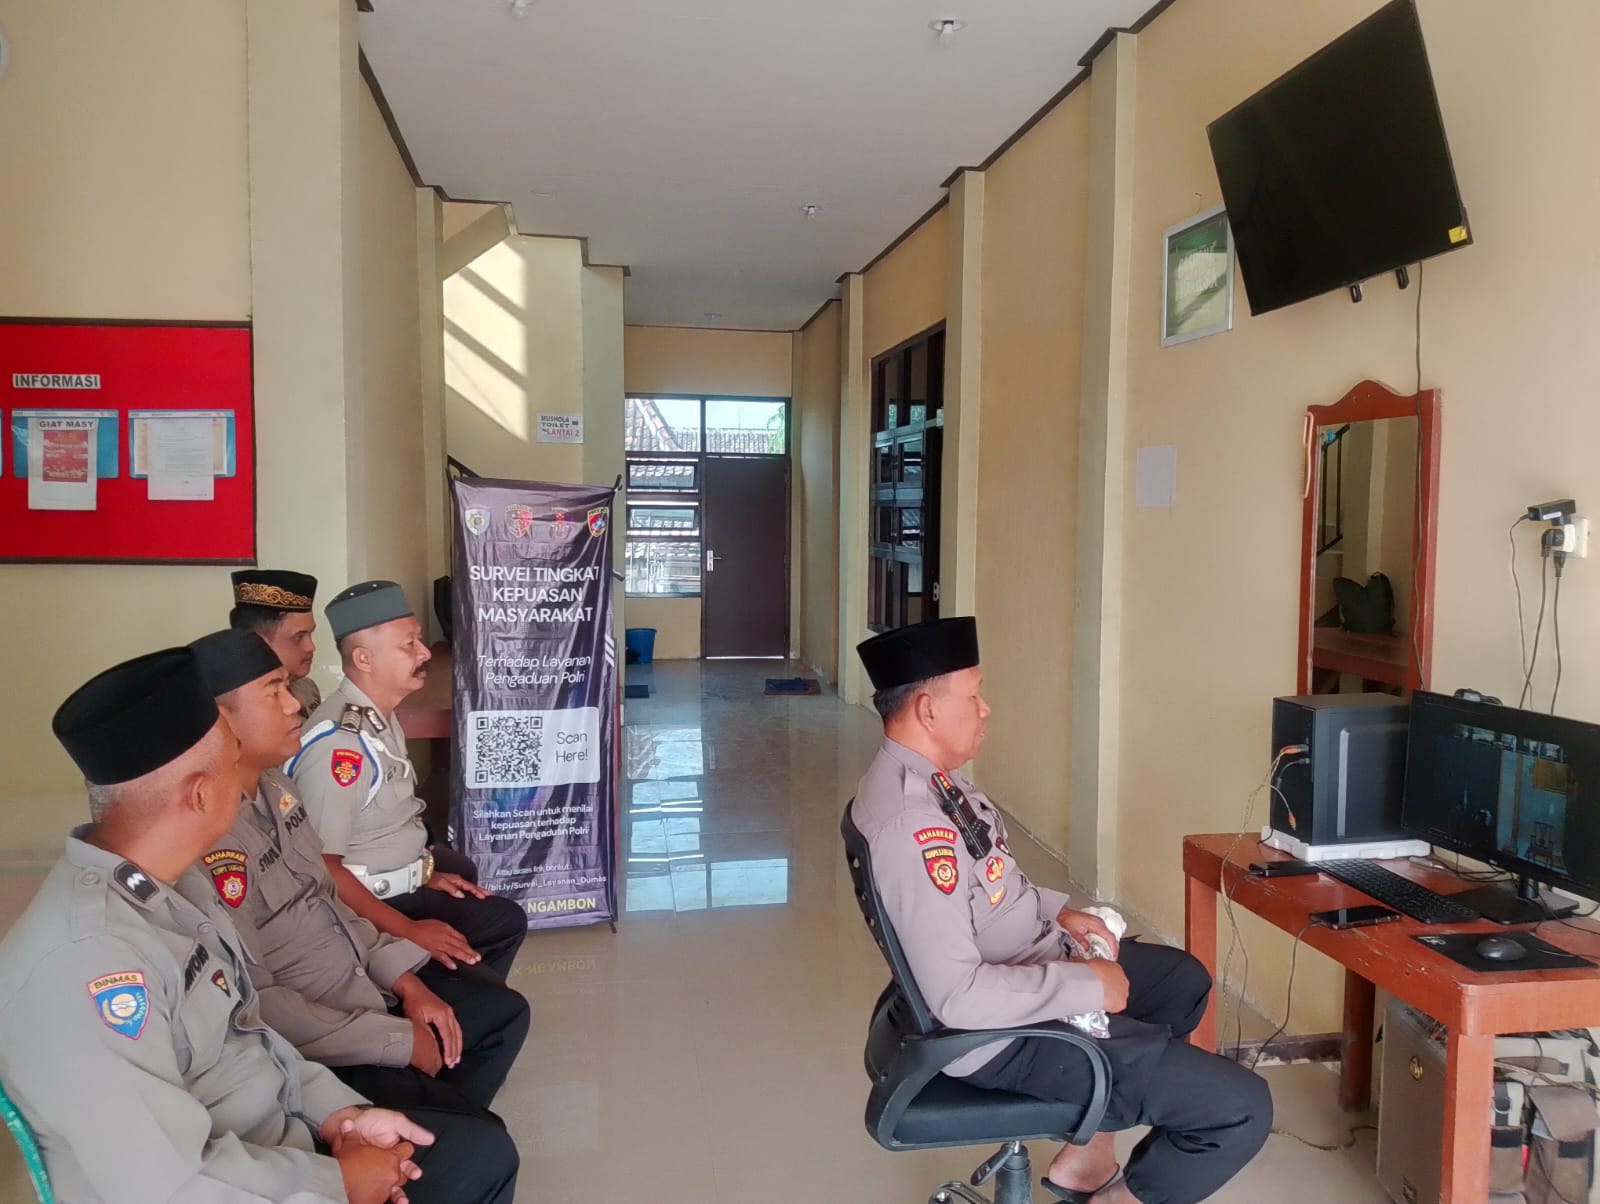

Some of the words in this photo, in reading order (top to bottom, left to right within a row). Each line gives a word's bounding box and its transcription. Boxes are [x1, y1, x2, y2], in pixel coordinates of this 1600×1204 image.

[14, 375, 98, 388] INFORMASI
[39, 420, 63, 428] GIAT
[66, 420, 94, 428] MASY
[470, 566, 531, 581] SURVEI
[534, 566, 600, 582] TINGKAT
[493, 587, 583, 602] KEPUASAN
[478, 607, 593, 622] MASYARAKAT
[478, 656, 539, 669] Terhadap
[542, 656, 591, 669] Layanan
[485, 672, 557, 686] Pengaduan
[561, 671, 585, 683] Polri
[556, 731, 588, 745] Scan
[555, 748, 588, 764] Here!
[473, 809, 511, 819] Silahkan
[513, 808, 535, 817] Scan
[536, 807, 561, 816] untuk
[491, 820, 536, 831] kepuasan
[537, 815, 577, 827] terhadap
[479, 832, 518, 842] Layanan
[519, 829, 568, 840] Pengaduan
[527, 898, 596, 913] NGAMBON
[94, 974, 138, 989] BINMAS
